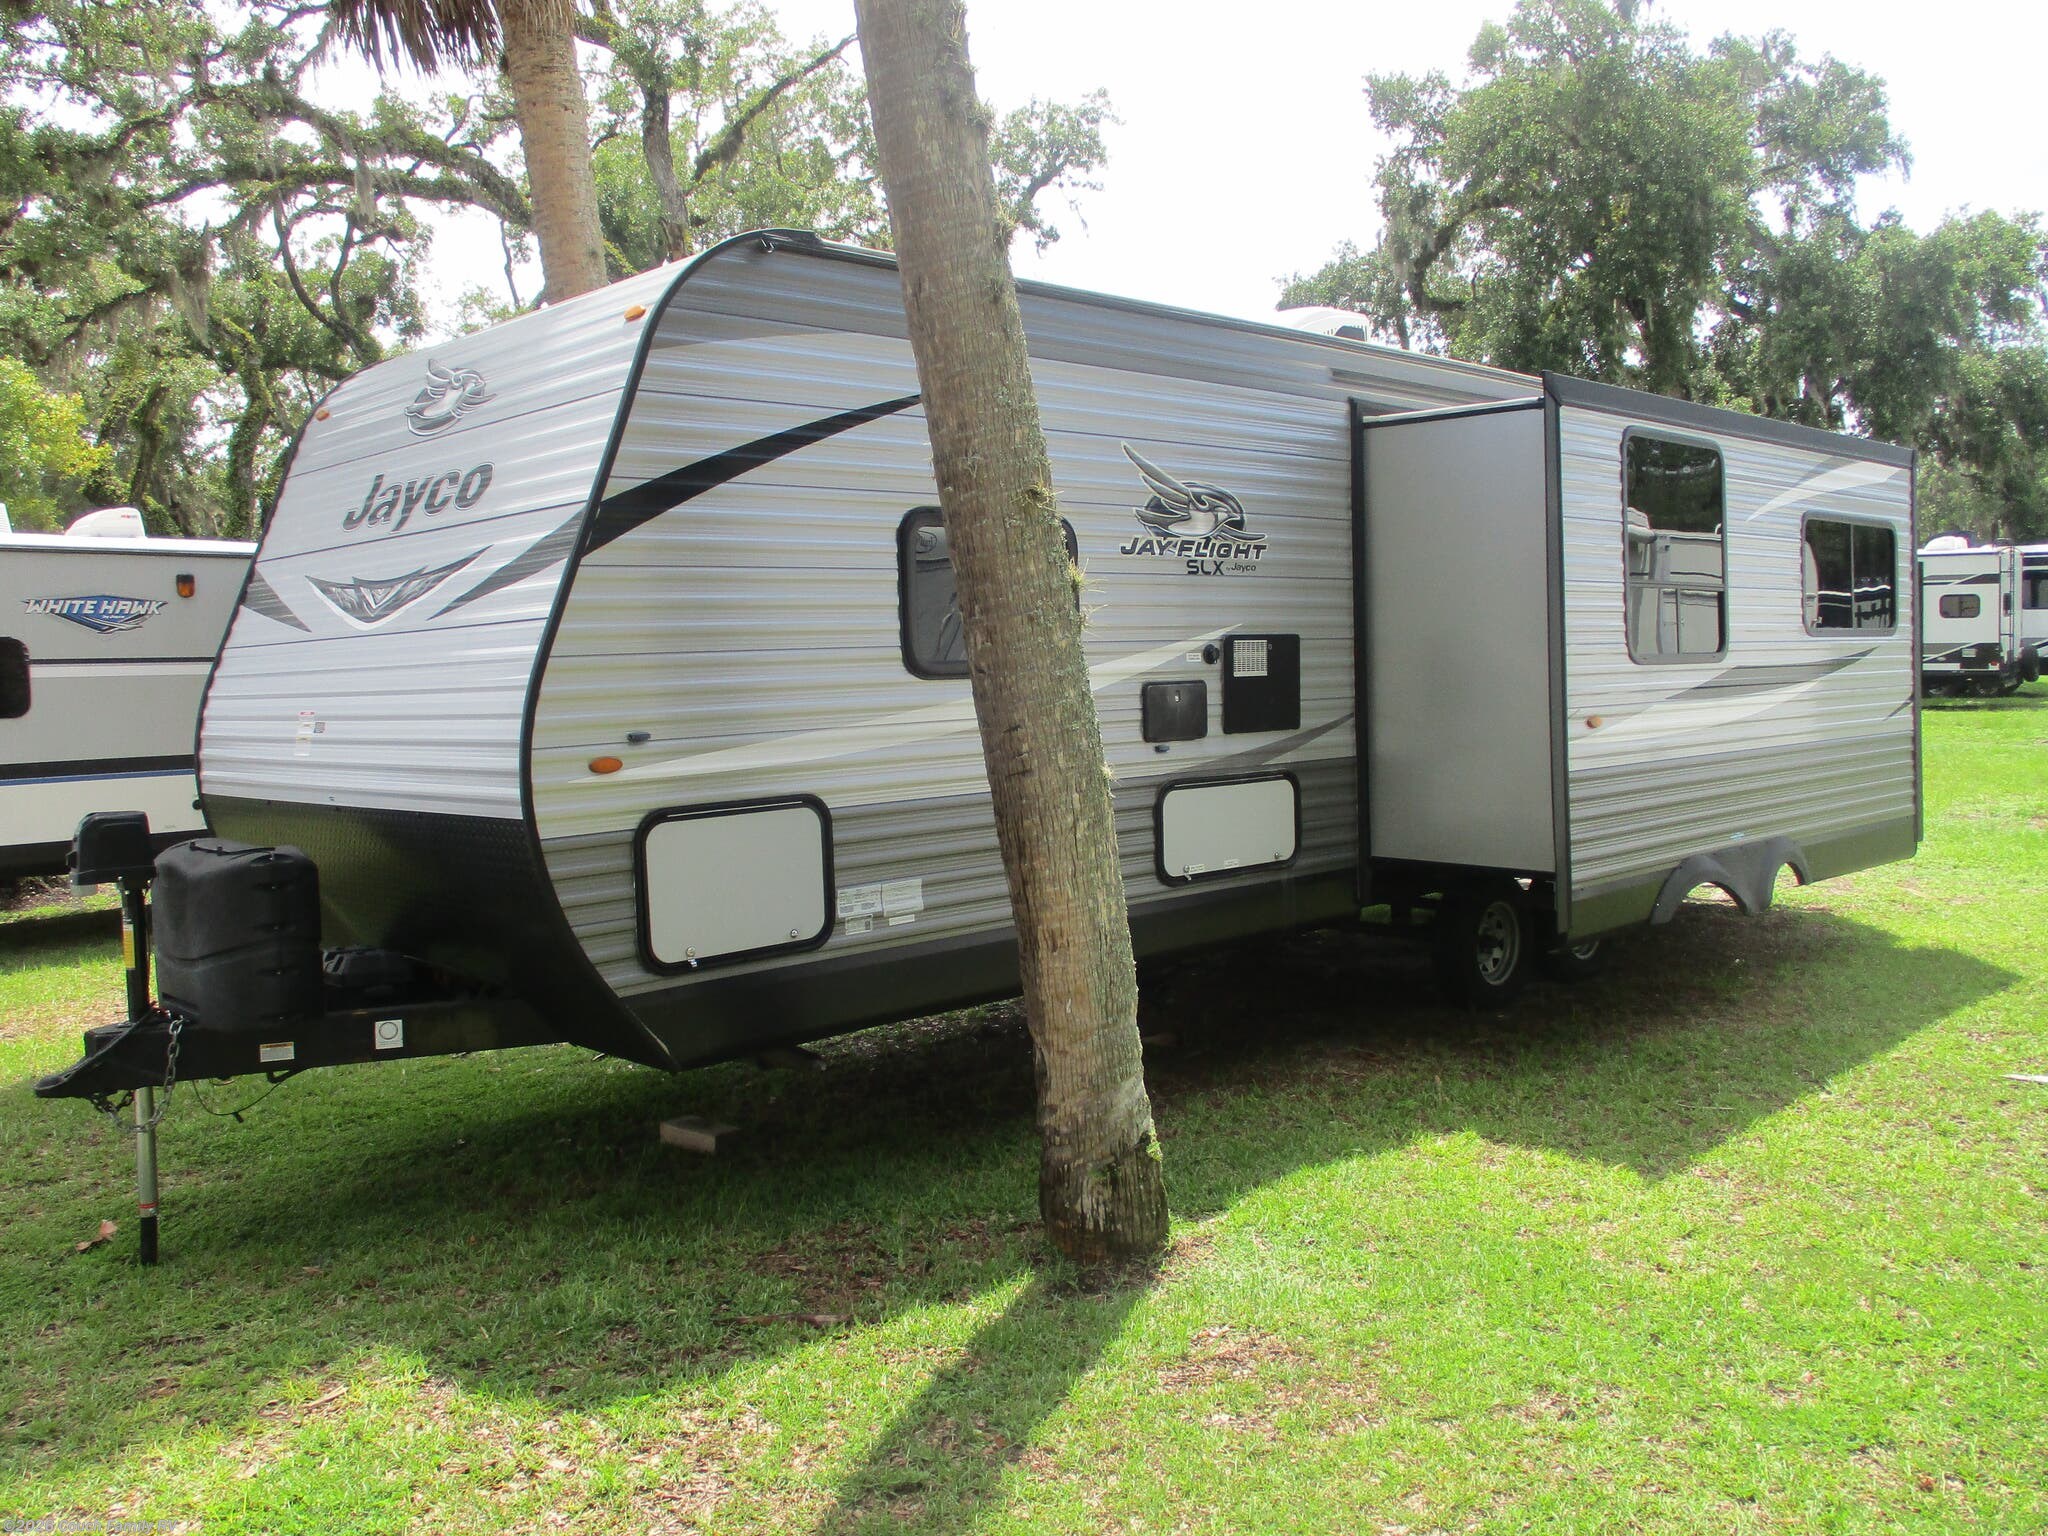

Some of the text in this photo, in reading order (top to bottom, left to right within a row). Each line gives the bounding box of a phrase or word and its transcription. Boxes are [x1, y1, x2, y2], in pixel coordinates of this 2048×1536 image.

[342, 462, 495, 533] Jayco
[1120, 537, 1268, 560] JAY FLIGHT
[1186, 560, 1225, 576] SLX
[1231, 562, 1257, 573] Jayco
[25, 598, 162, 615] WHITE HAWK
